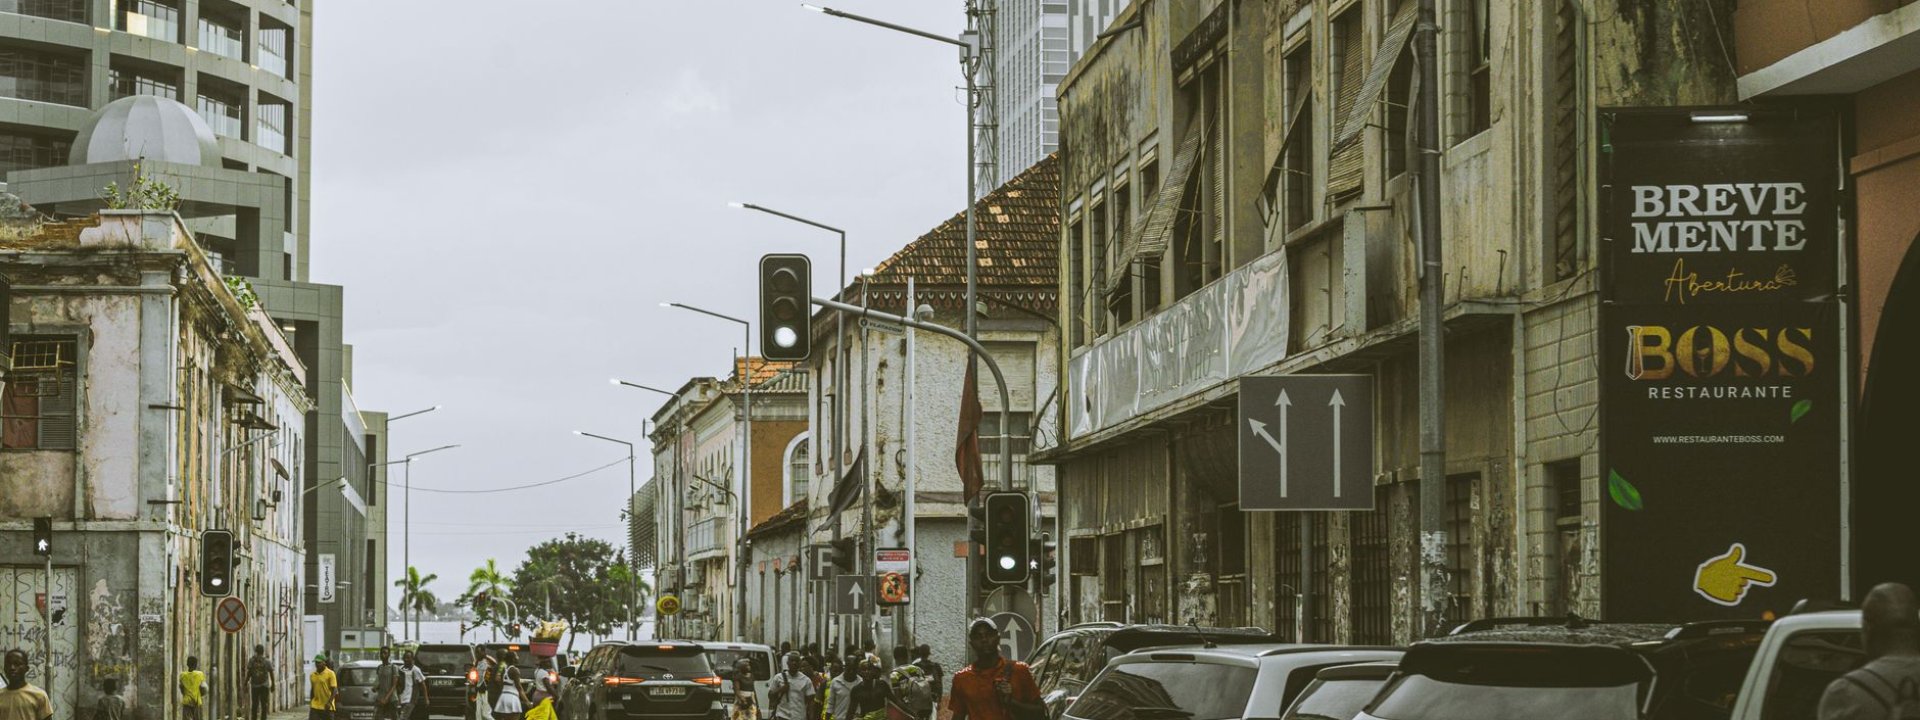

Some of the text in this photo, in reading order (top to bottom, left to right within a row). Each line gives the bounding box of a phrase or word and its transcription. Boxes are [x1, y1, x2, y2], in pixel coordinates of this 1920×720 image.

[1631, 182, 1807, 217] BREVE
[1631, 219, 1807, 253] MENTE
[1664, 258, 1783, 304] Abertura
[1625, 325, 1815, 381] BOSS
[1648, 386, 1792, 399] RESTAURANTE
[1653, 435, 1785, 443] WWW.RESTAURANTEBOSS.COM
